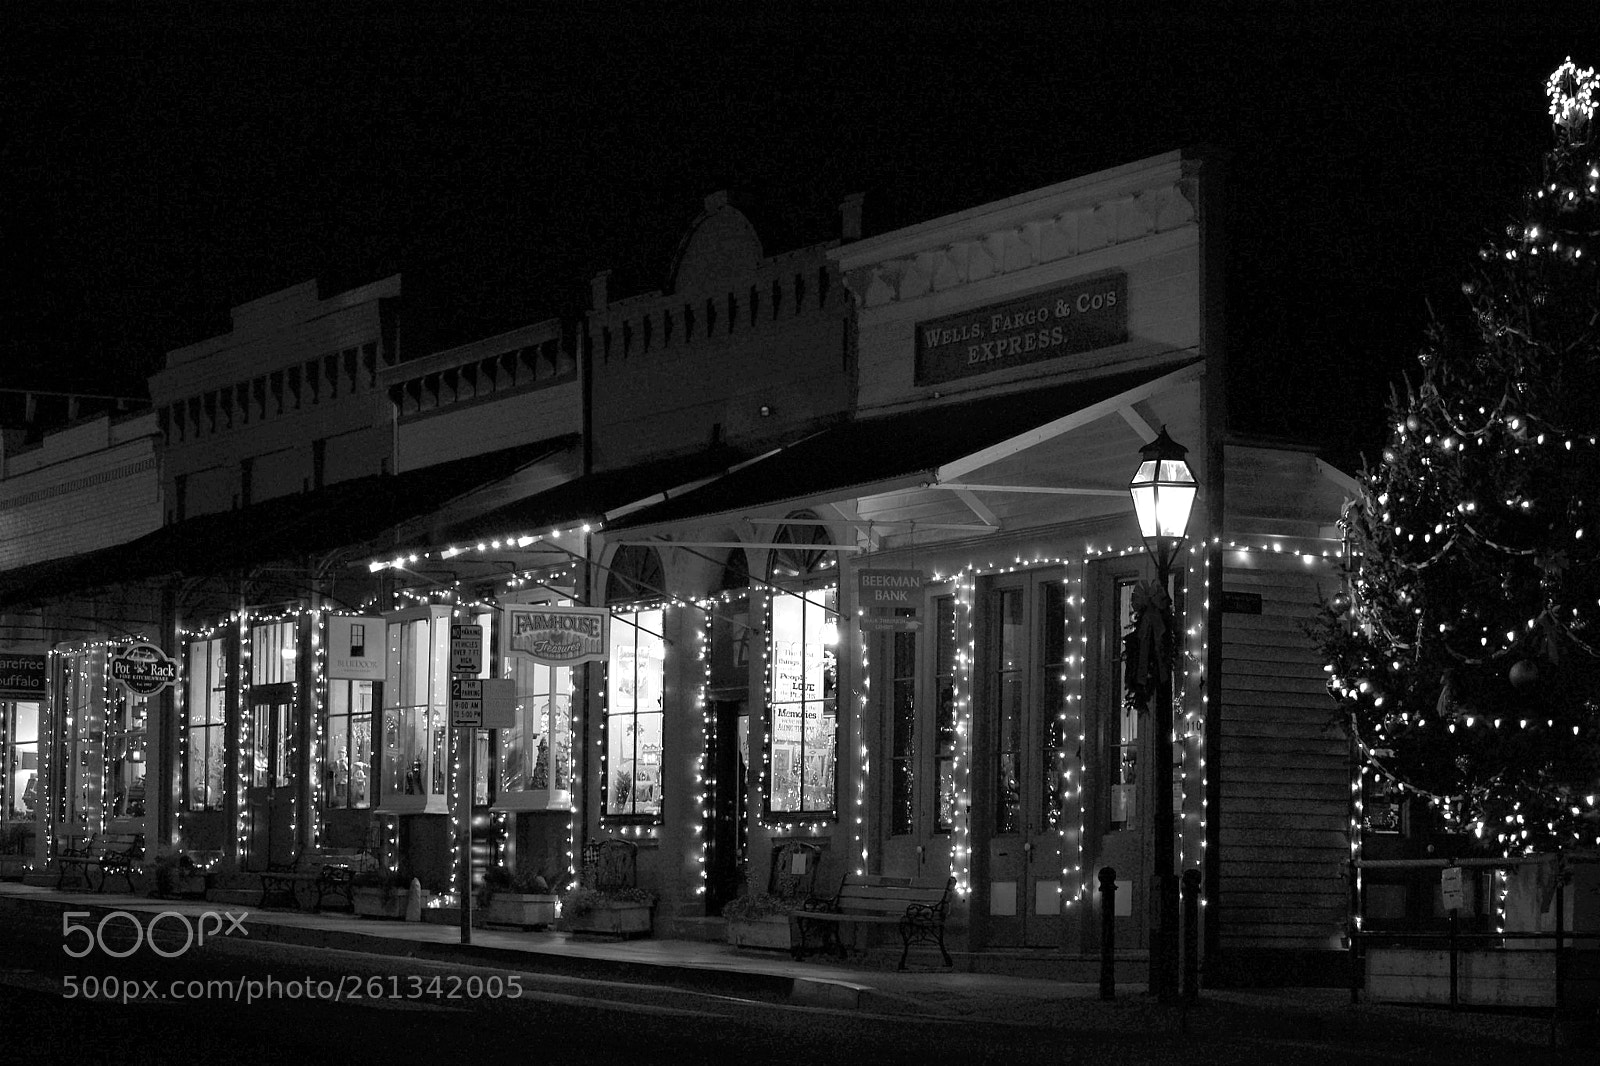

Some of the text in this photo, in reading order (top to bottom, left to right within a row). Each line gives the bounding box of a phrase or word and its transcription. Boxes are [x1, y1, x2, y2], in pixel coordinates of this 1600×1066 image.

[1055, 299, 1071, 317] &
[862, 575, 920, 587] BEEKMAN
[874, 589, 908, 601] BANK
[514, 613, 600, 638] FARMHOUSE
[534, 640, 581, 654] Treasures
[115, 661, 174, 677] Pot Rack
[453, 683, 460, 695] 2
[461, 689, 480, 697] PARKING
[455, 701, 469, 709] 9:00
[453, 710, 460, 718] TO
[461, 710, 473, 718] 5:00
[777, 708, 817, 719] Memoies
[1186, 720, 1202, 731] 110
